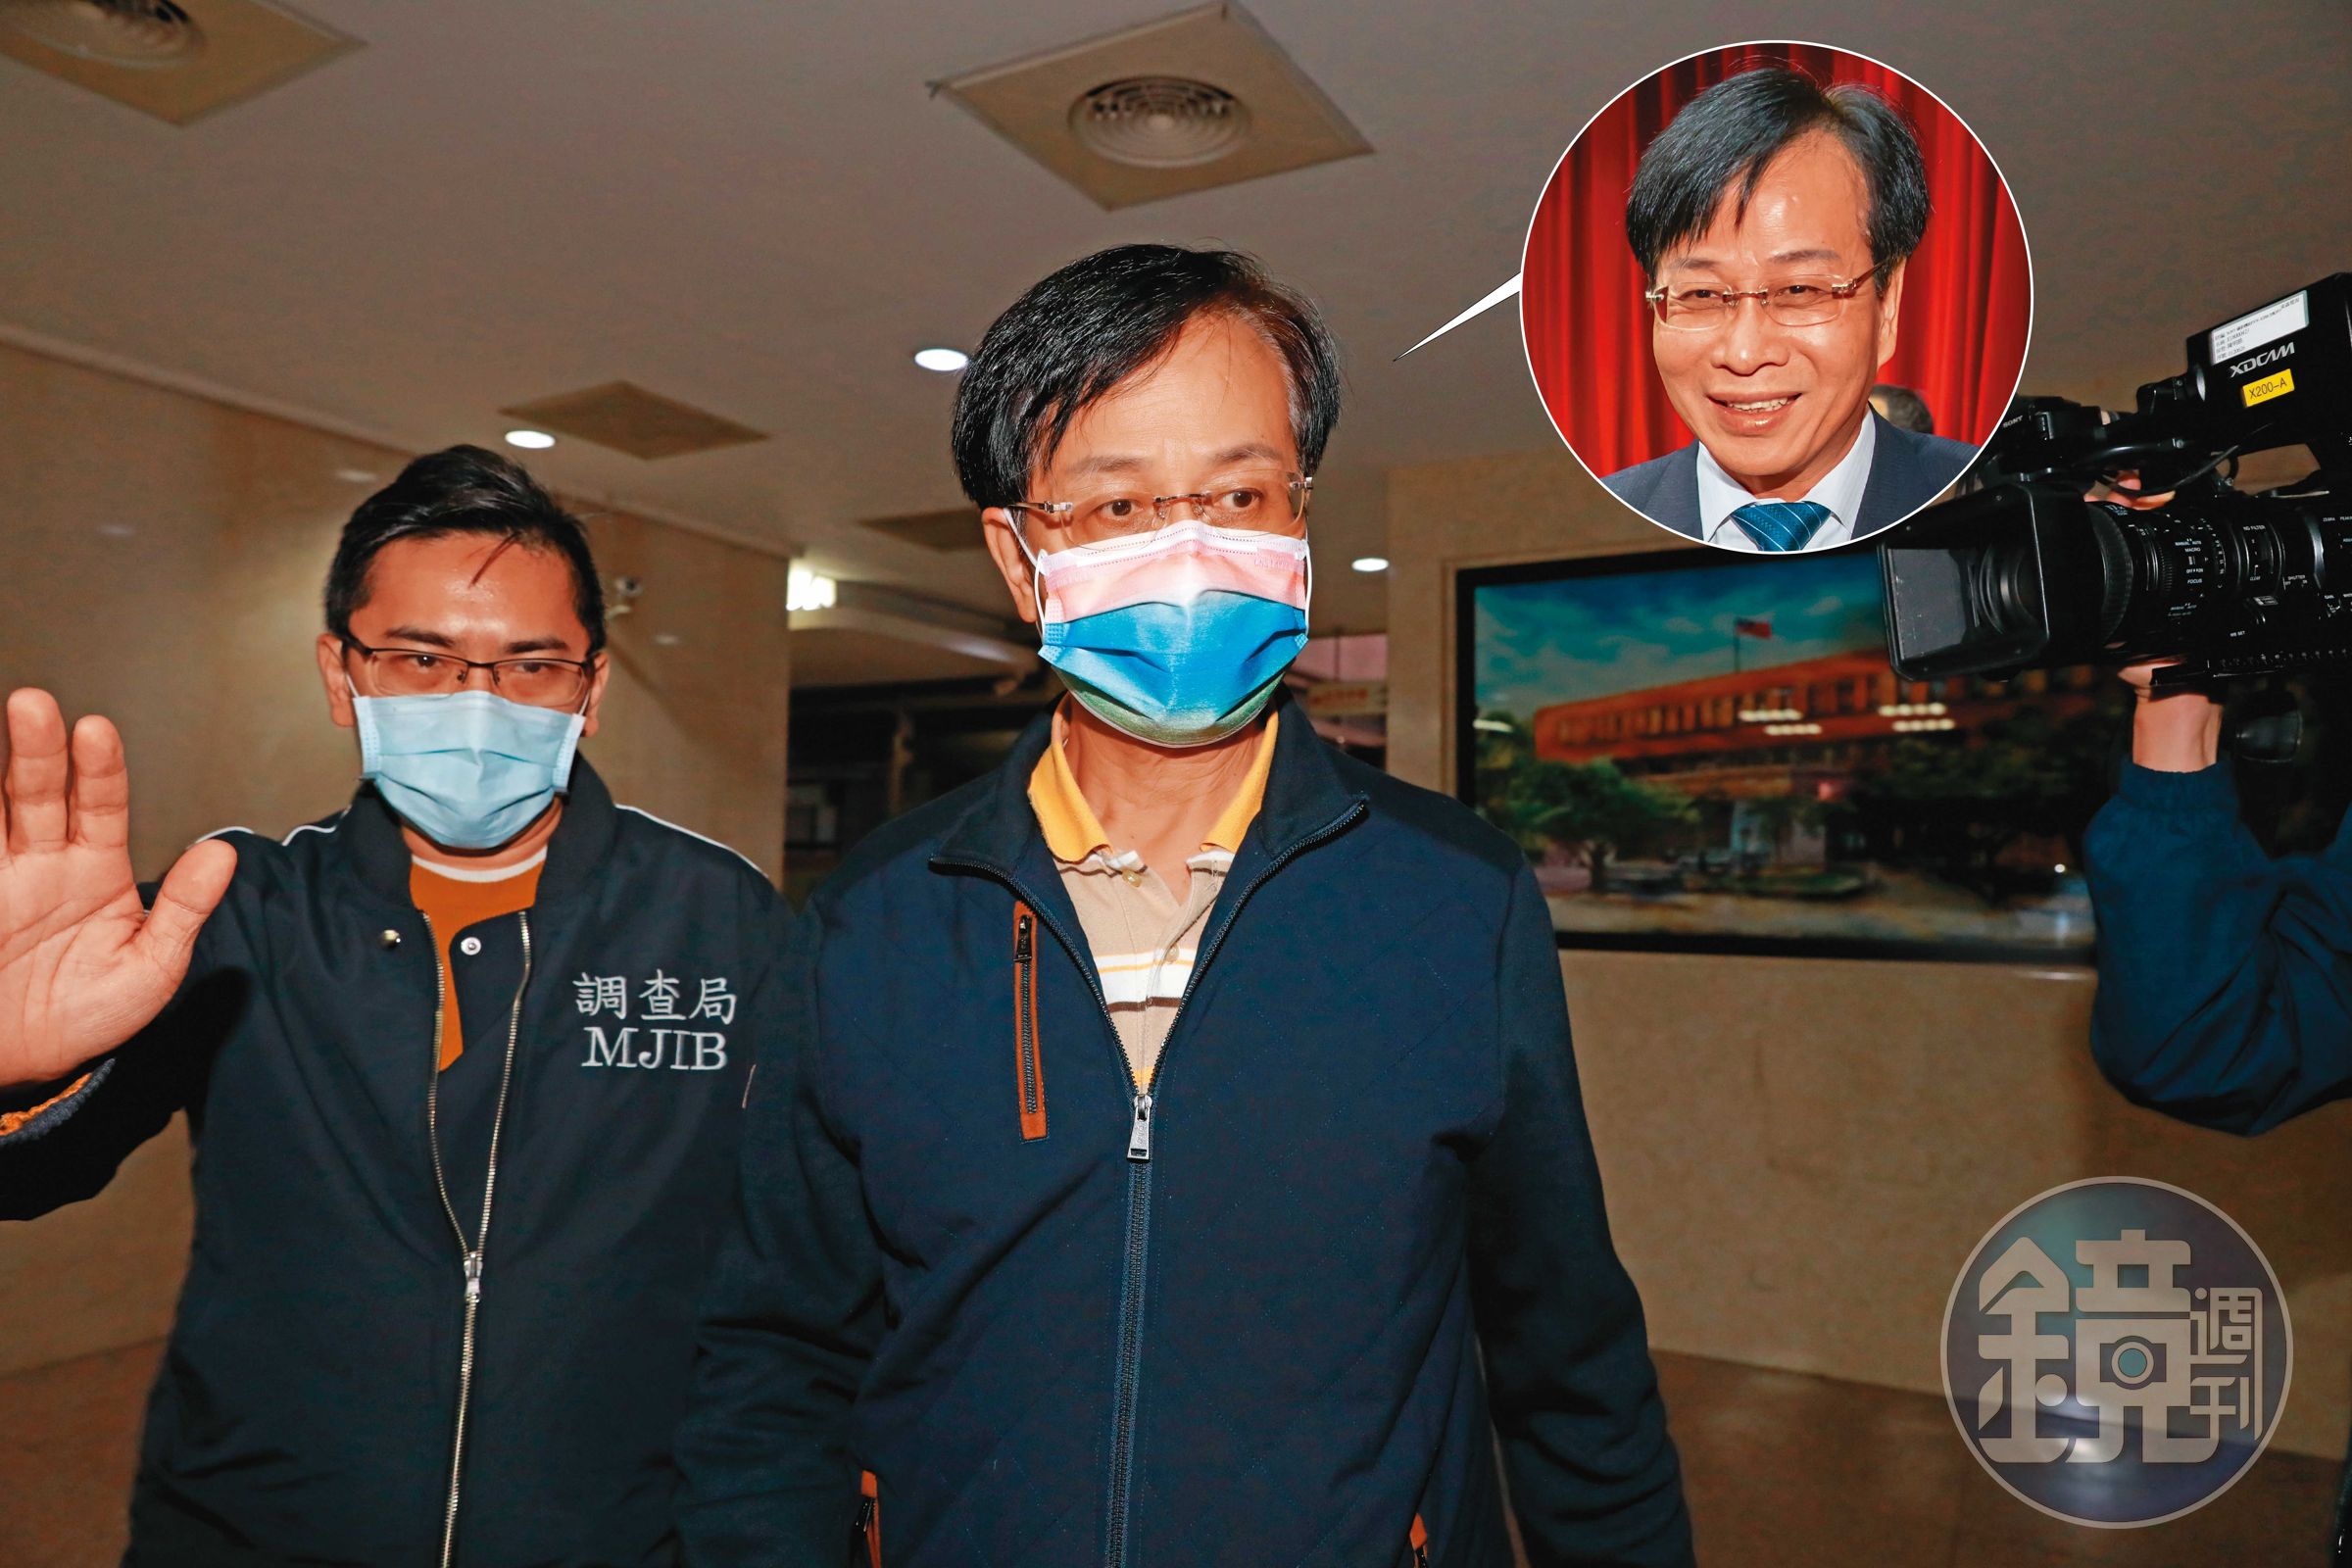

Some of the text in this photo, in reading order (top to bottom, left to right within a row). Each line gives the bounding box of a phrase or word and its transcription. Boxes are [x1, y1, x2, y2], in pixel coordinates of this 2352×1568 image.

[2230, 342, 2295, 377] XDCAM
[2249, 376, 2287, 400] X200-A
[2002, 416, 2024, 428] SONY
[572, 968, 737, 1025] 調查局
[581, 1026, 727, 1070] MJIB
